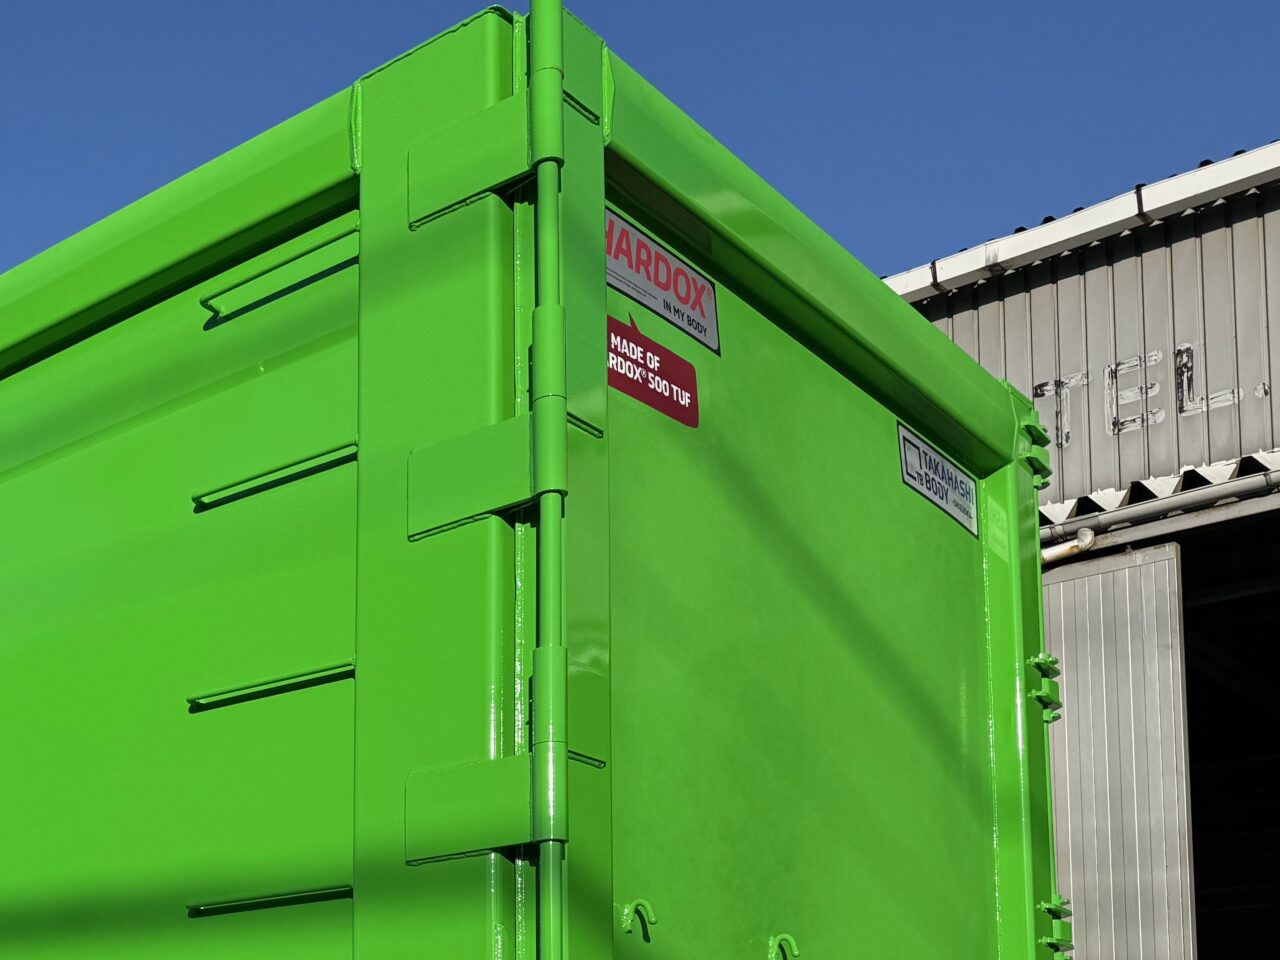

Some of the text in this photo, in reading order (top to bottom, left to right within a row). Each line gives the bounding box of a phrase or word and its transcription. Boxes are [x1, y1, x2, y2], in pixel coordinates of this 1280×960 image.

[663, 298, 707, 337] IN MY BODY
[611, 332, 660, 371] MADE OF
[648, 372, 669, 397] 500
[671, 383, 691, 407] TUF
[922, 449, 974, 505] TAKAHASHI
[924, 471, 949, 504] BODY
